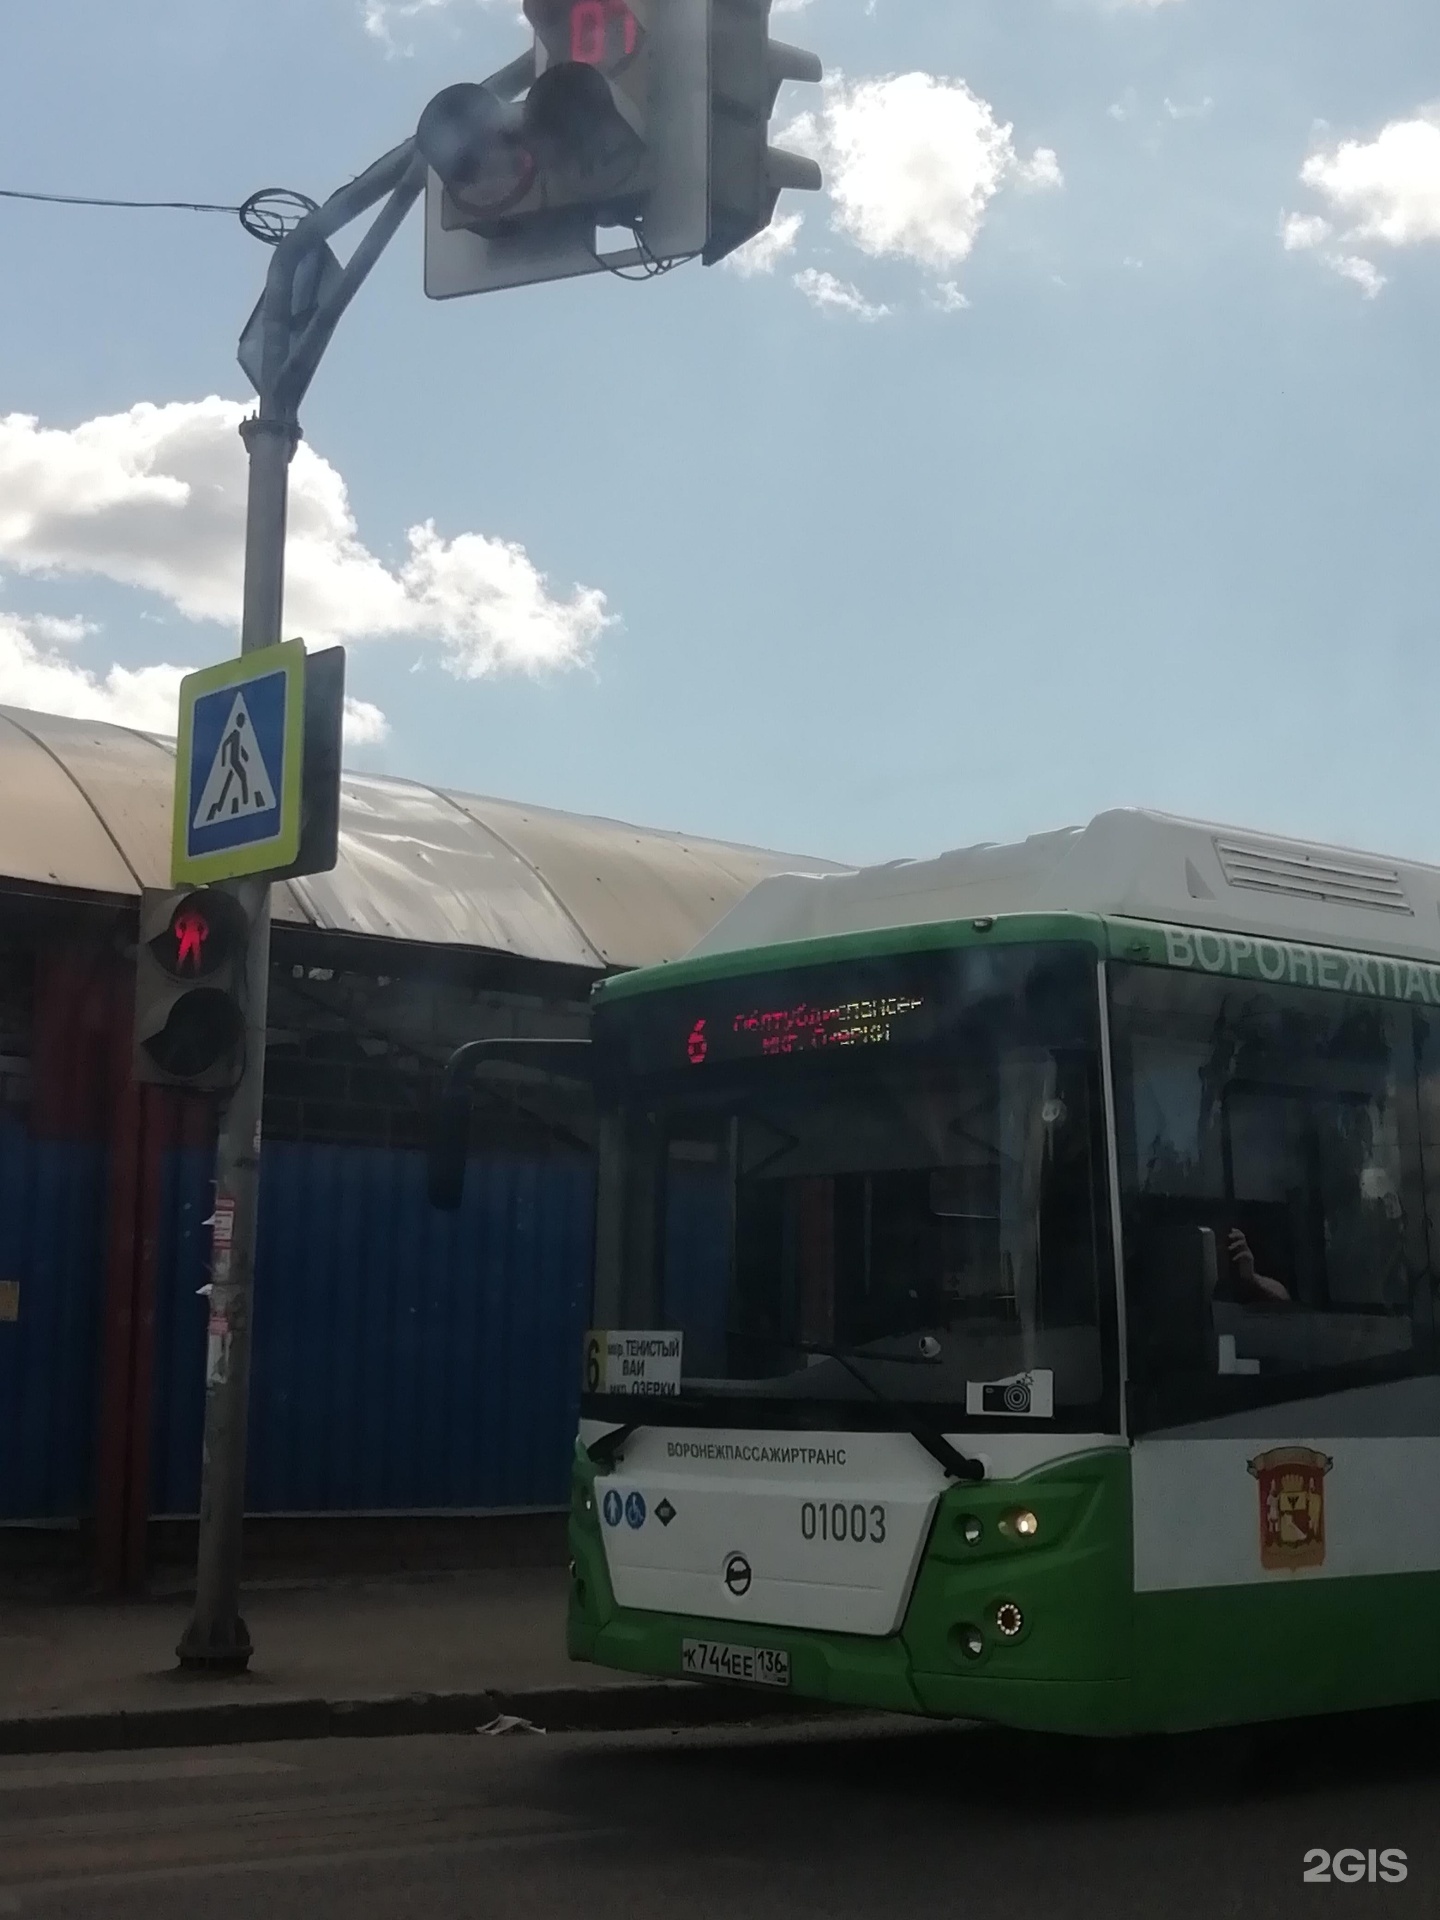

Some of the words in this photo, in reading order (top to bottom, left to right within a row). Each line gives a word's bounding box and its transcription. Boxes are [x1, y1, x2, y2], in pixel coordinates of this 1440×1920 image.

[688, 1019, 708, 1064] 6
[626, 1338, 680, 1357] ТЕНИСТЫЙ
[588, 1339, 600, 1393] 6
[622, 1359, 645, 1377] ВАИ
[667, 1442, 847, 1466] ВОРОНЕЖПАССАЖИРТРАНС
[801, 1502, 886, 1543] 01003
